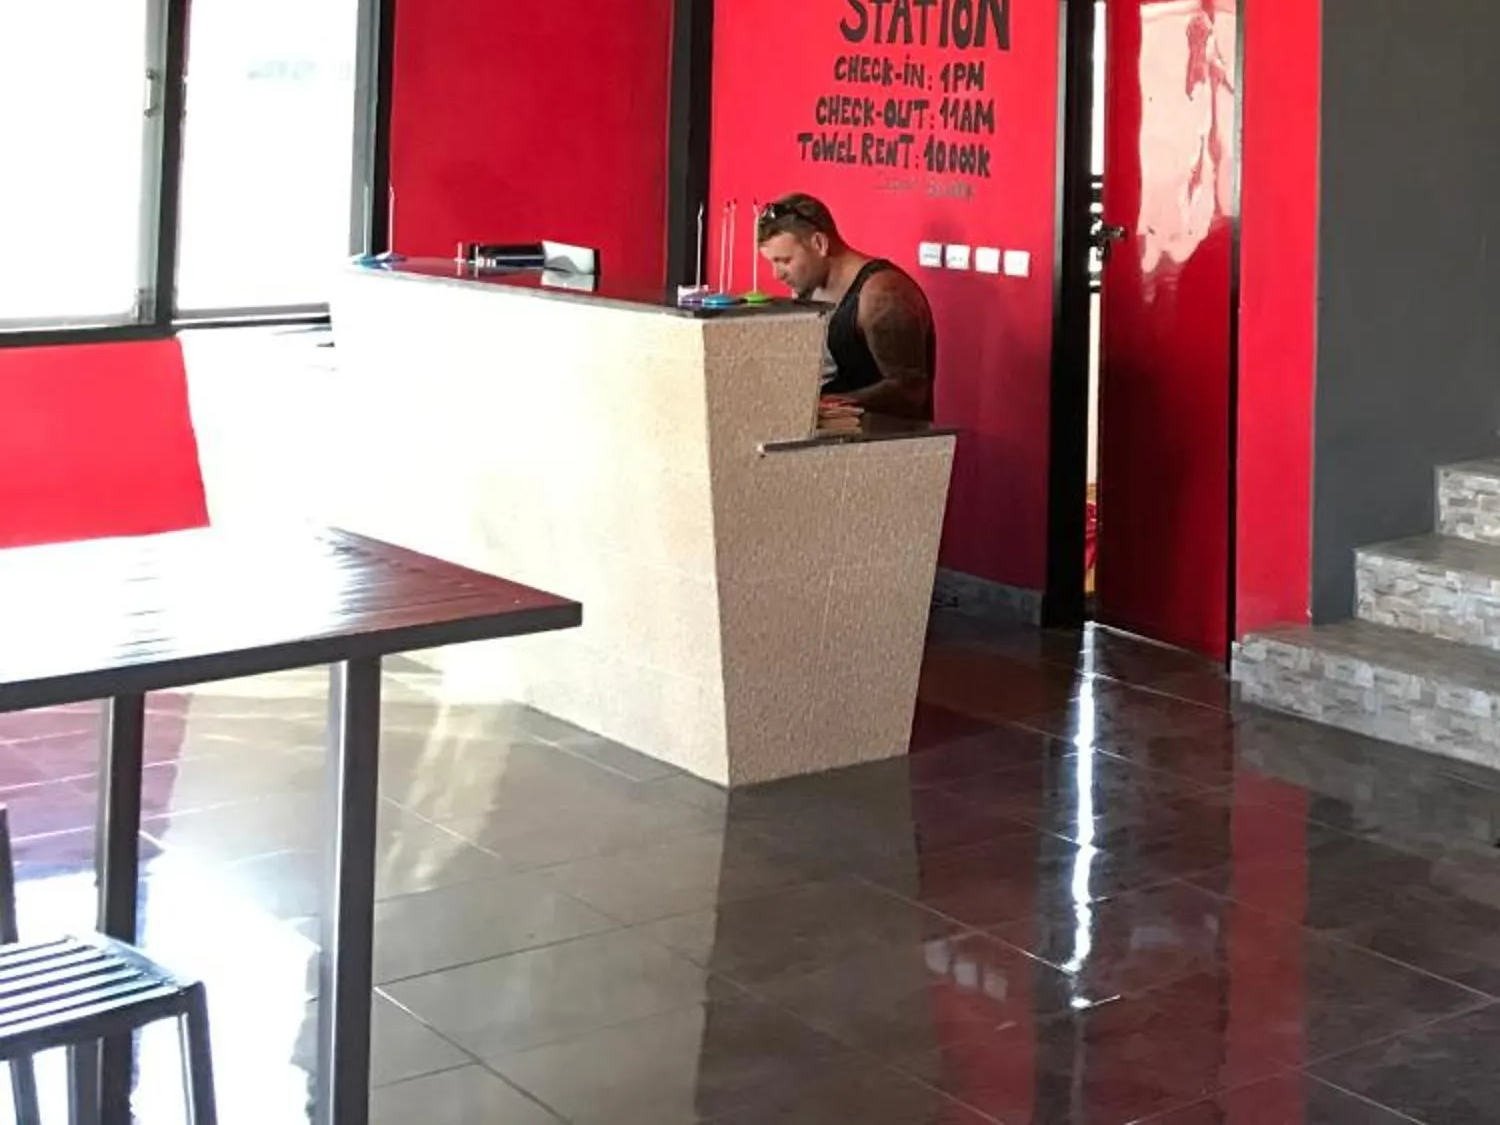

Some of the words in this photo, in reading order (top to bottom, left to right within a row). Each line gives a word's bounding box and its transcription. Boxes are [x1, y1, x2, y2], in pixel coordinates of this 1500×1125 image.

[939, 60, 985, 93] 1PM
[939, 97, 995, 135] 11AM
[797, 132, 856, 164] TOWEL
